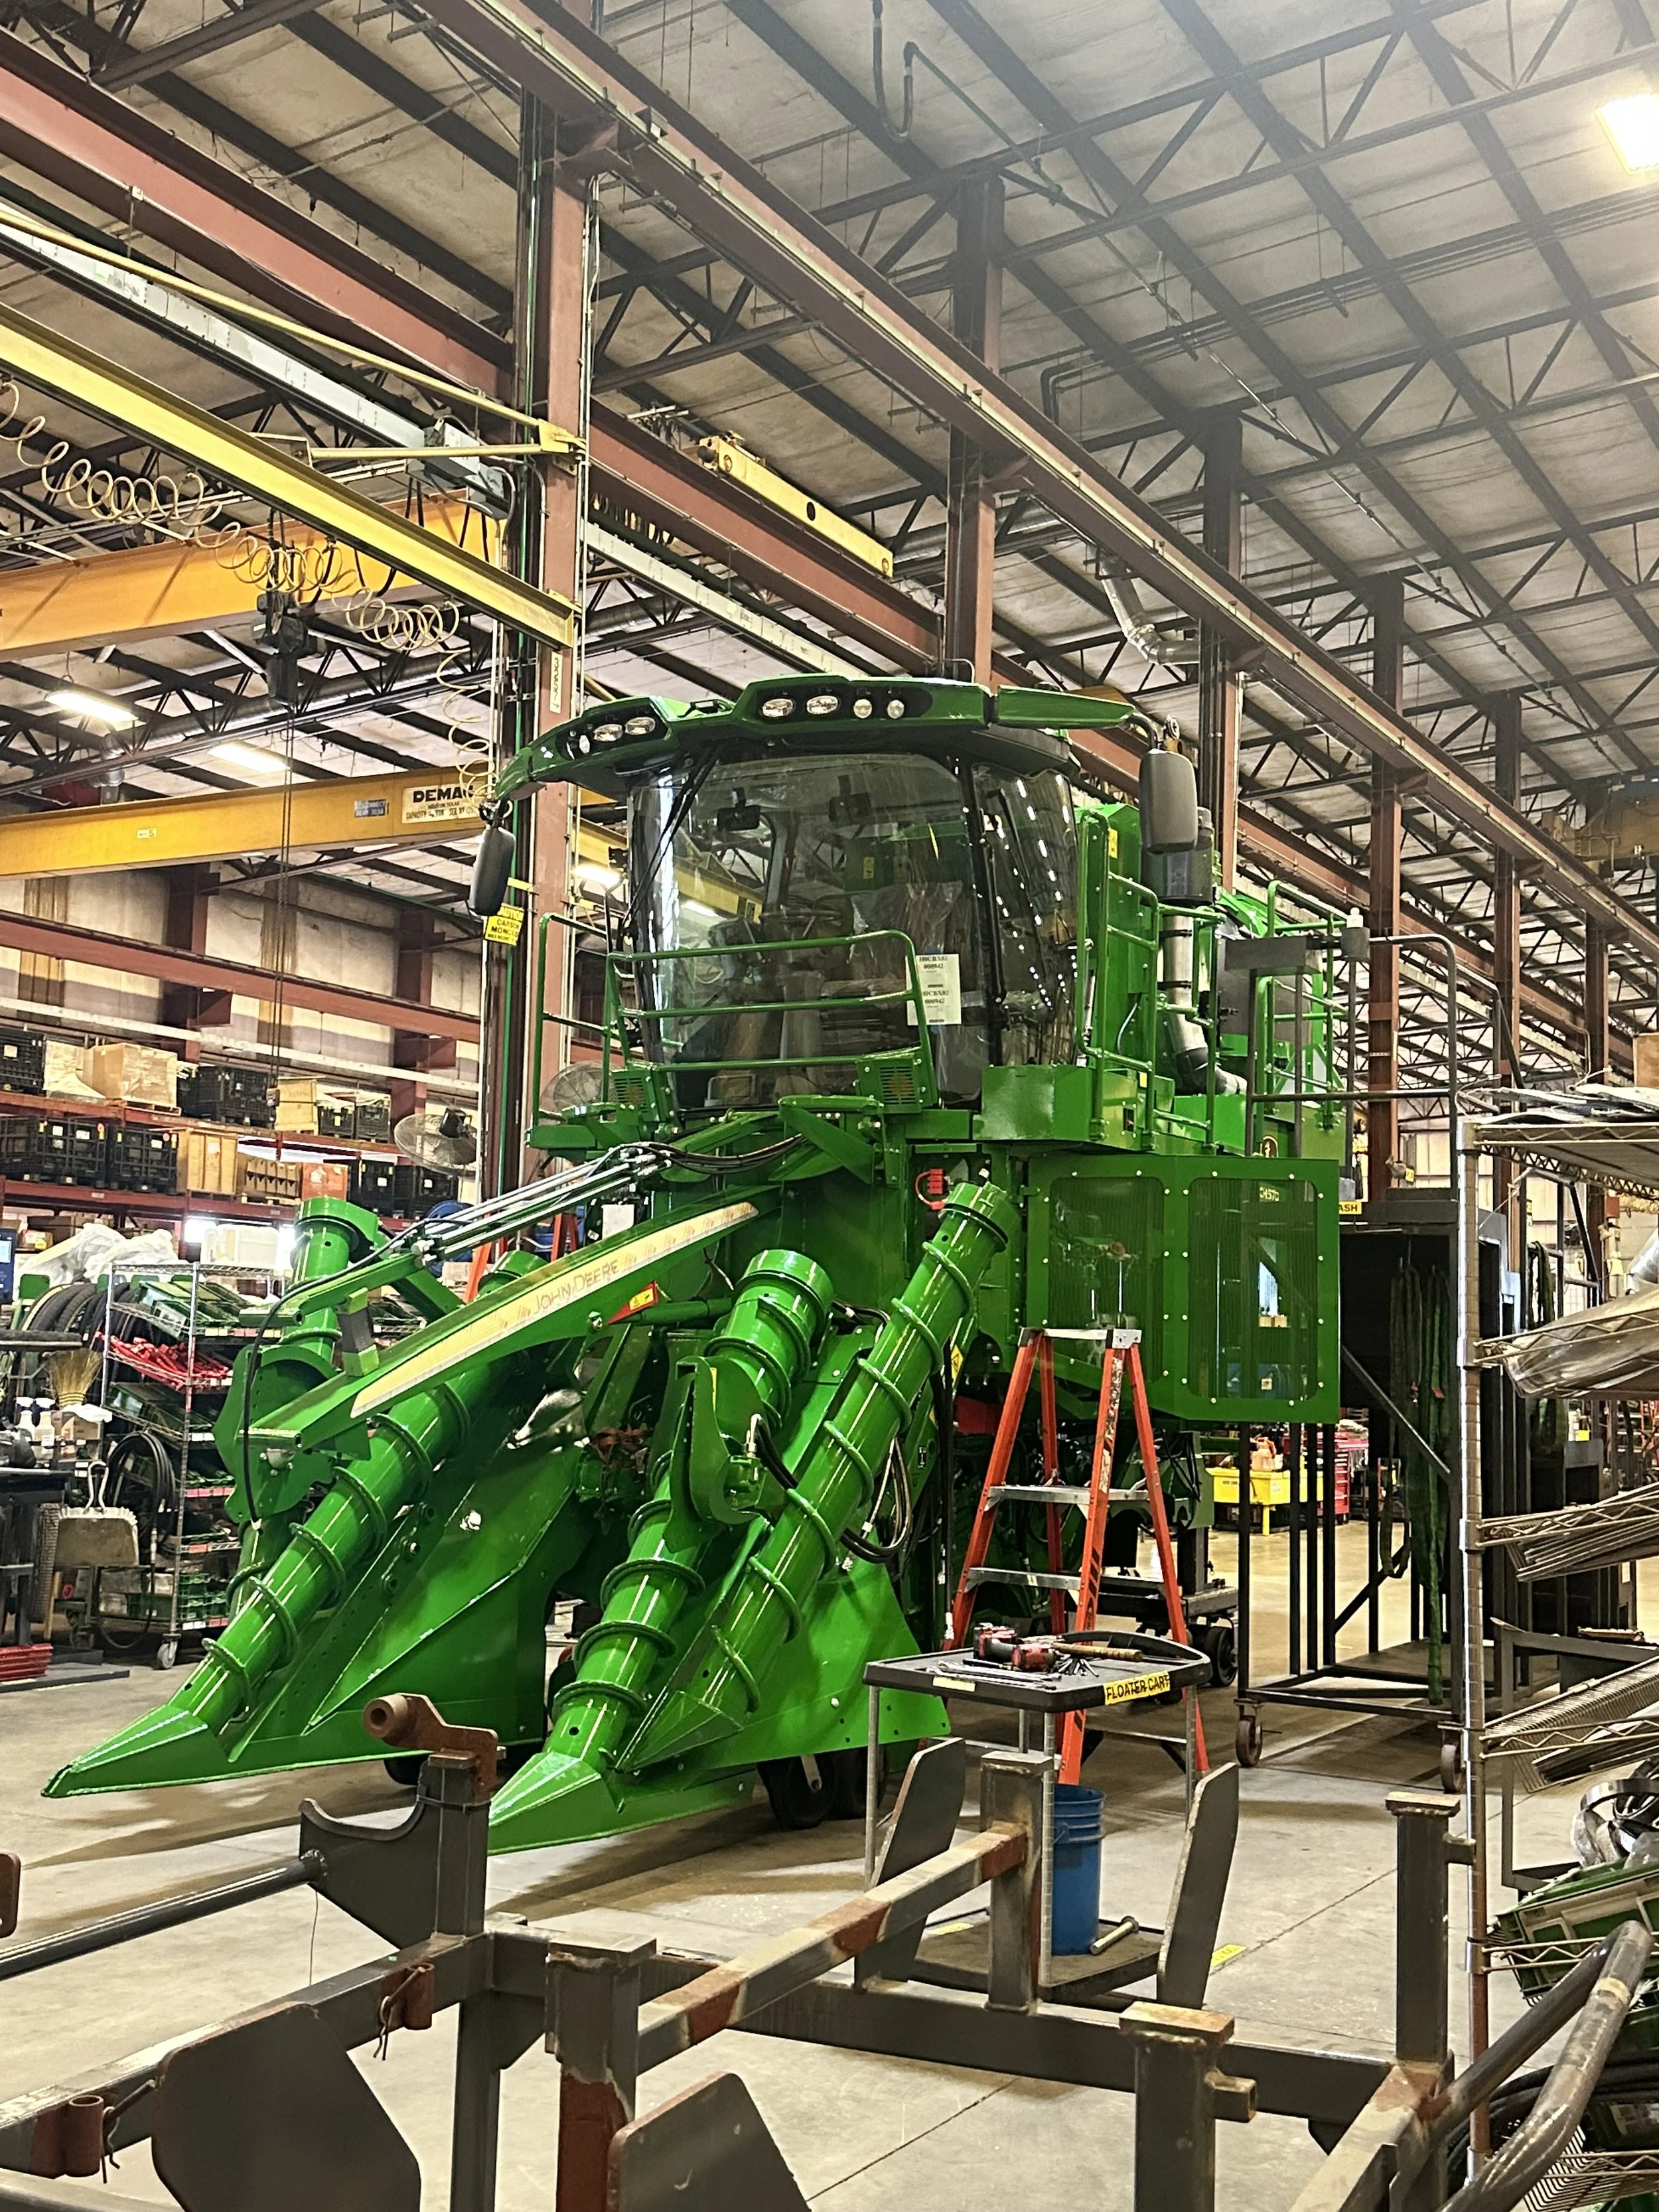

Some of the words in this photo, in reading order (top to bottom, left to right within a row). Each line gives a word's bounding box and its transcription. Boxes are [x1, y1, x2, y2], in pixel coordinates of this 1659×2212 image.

[406, 810, 427, 820] CAPACITY
[534, 1282, 571, 1315] JOHN
[573, 1259, 619, 1292] DEERE
[1106, 1679, 1147, 1700] FLOATER
[1148, 1674, 1170, 1691] CART
